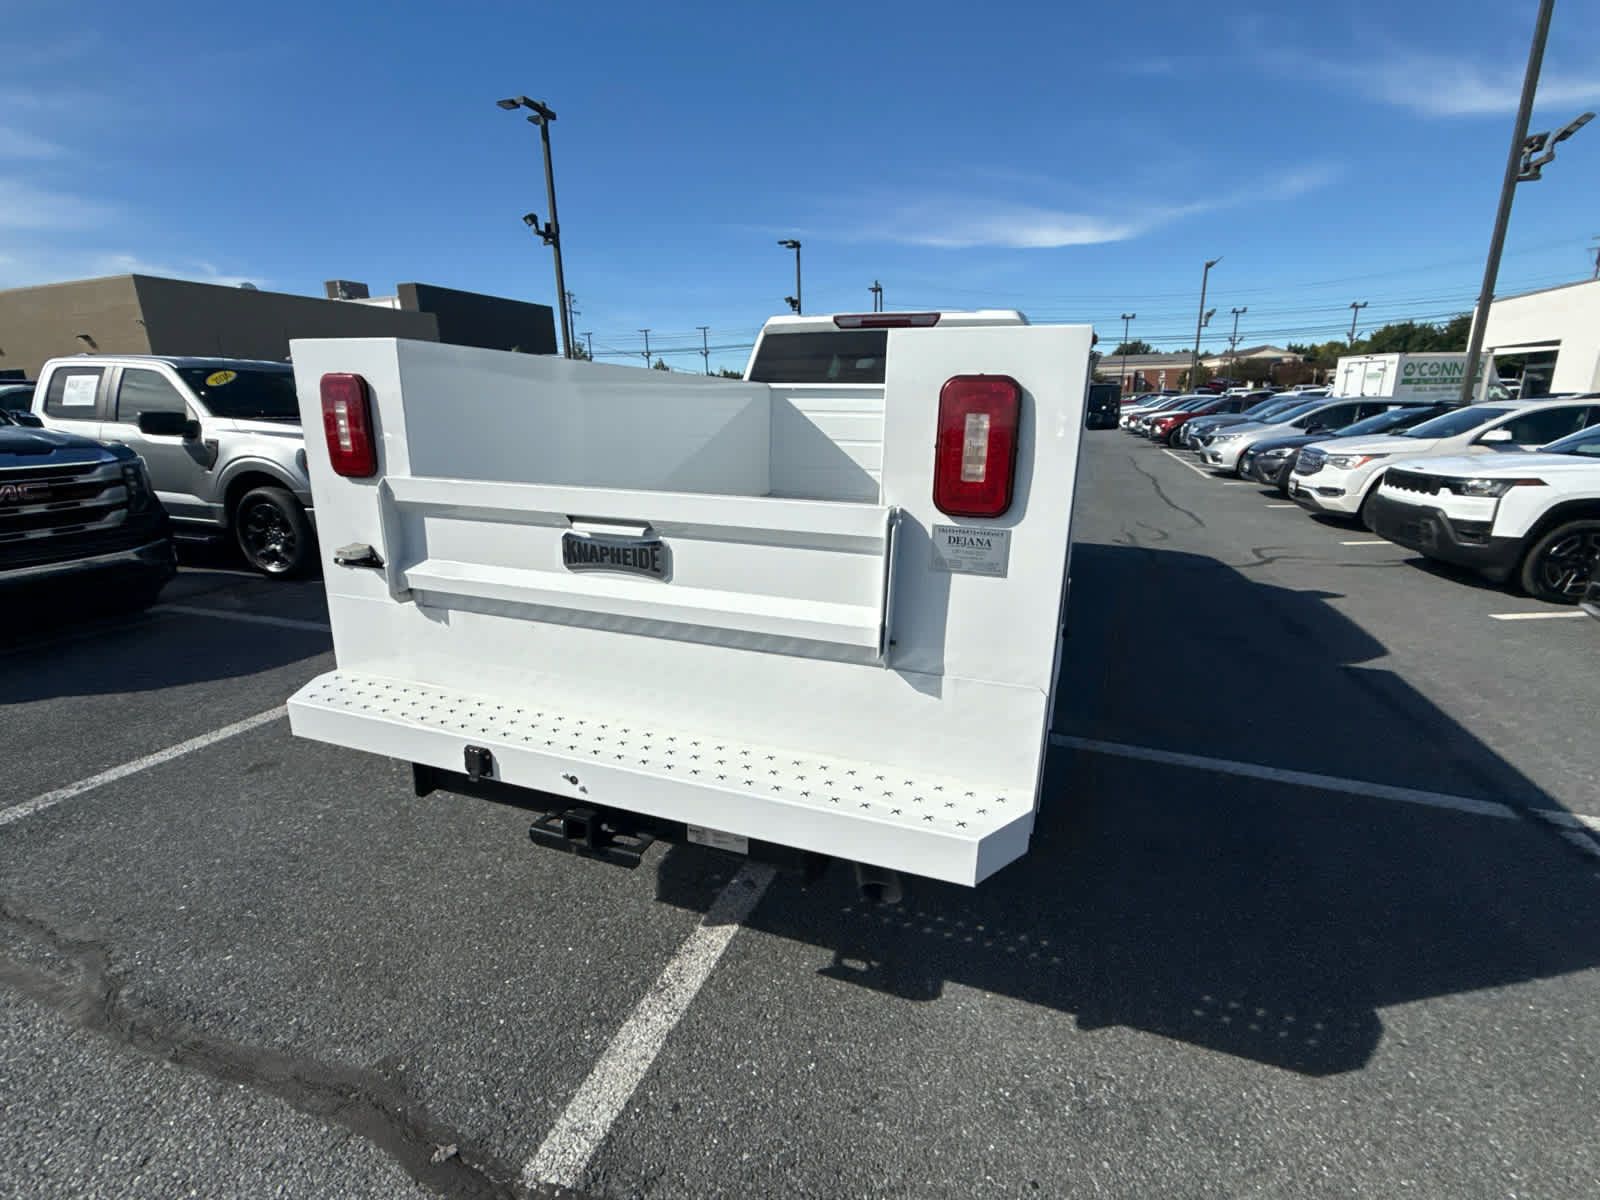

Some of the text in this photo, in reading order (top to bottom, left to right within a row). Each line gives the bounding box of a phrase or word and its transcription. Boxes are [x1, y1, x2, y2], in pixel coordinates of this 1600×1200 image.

[1403, 361, 1485, 377] O'CONNR
[947, 535, 992, 548] DEJANA
[565, 538, 660, 573] KNAPHEIDE
